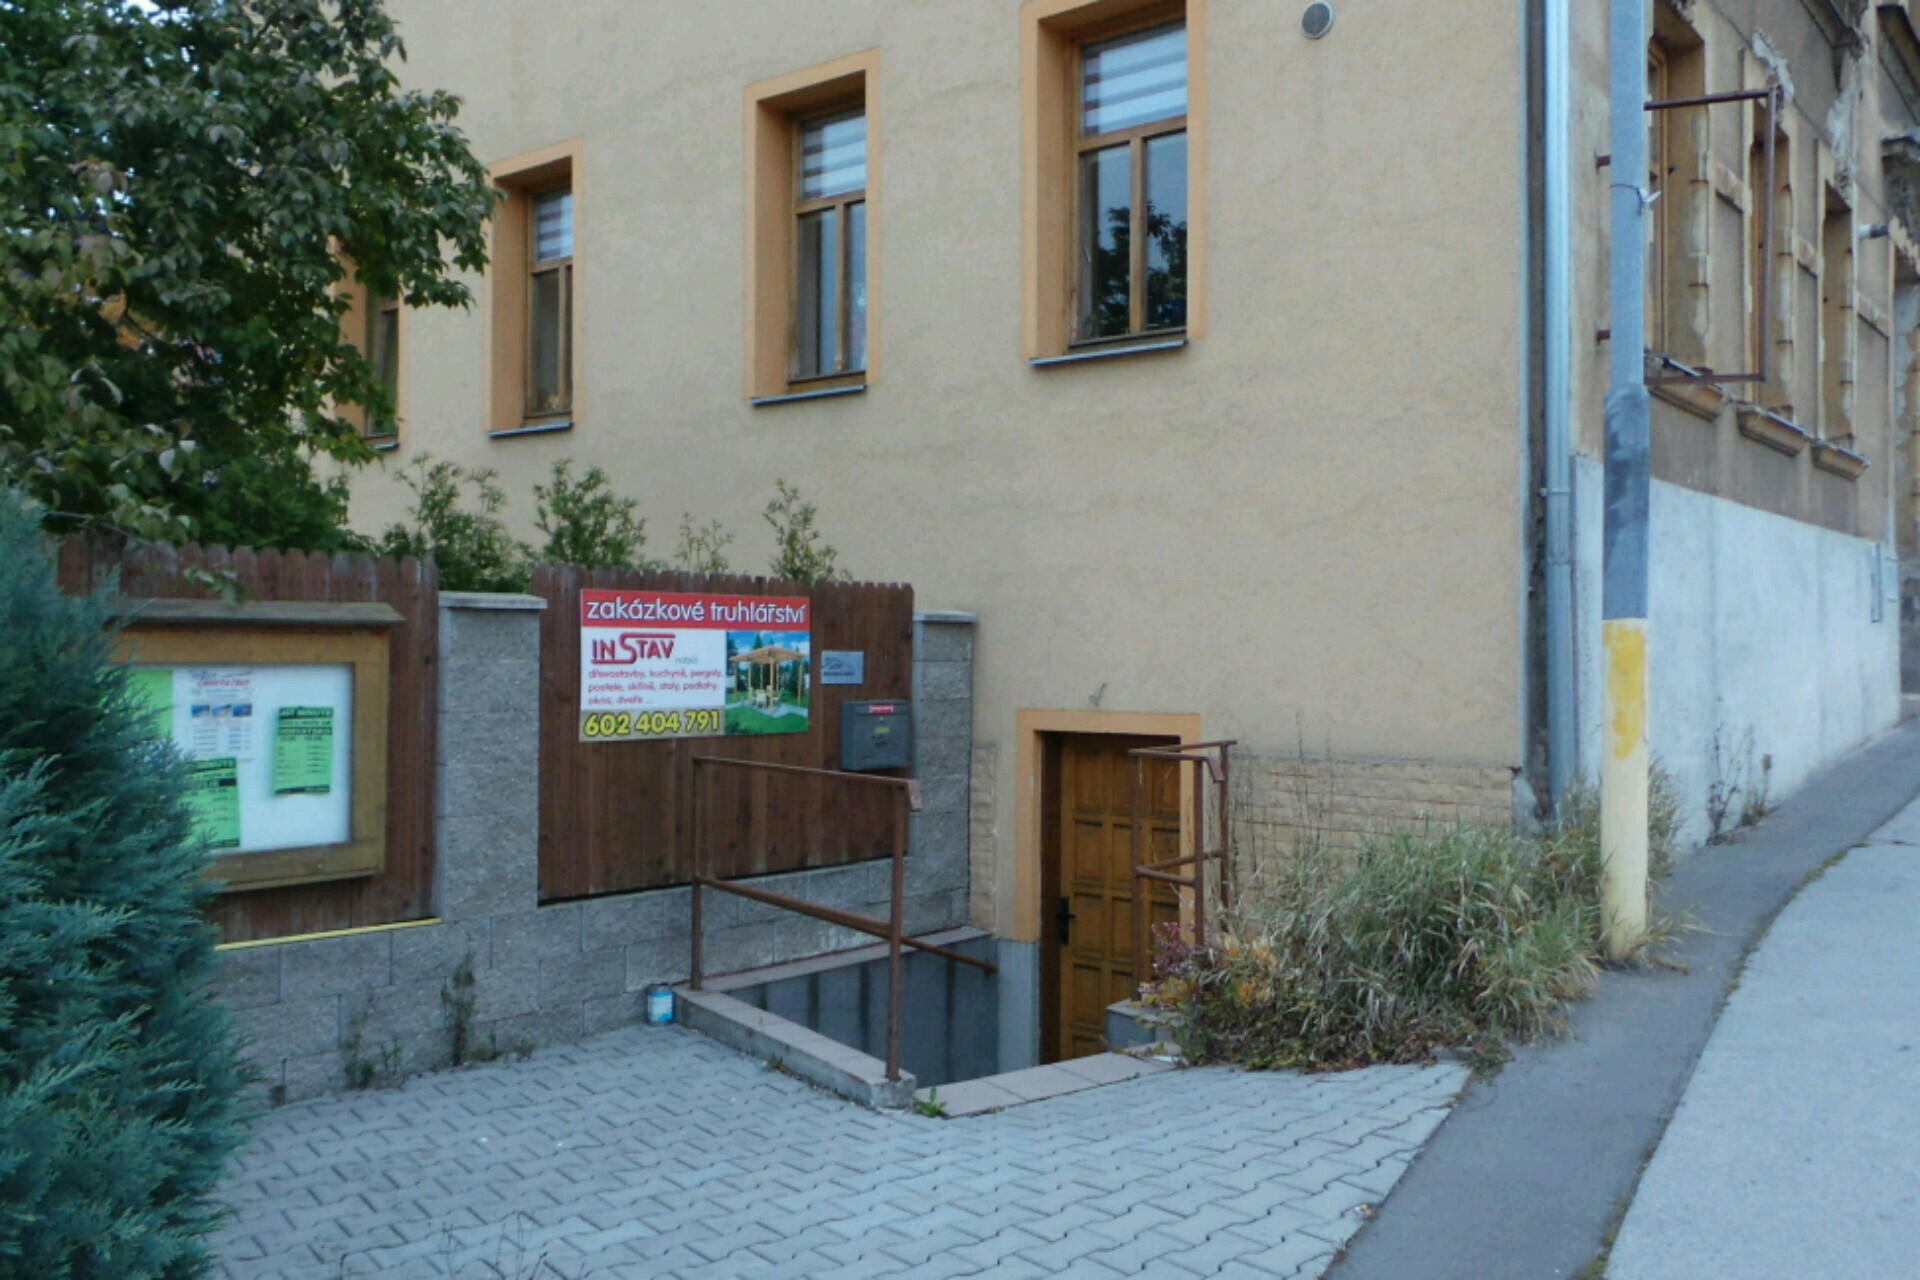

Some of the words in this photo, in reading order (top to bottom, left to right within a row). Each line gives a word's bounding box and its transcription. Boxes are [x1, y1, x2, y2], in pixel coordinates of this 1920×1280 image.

[587, 597, 704, 620] zakázkové
[710, 601, 806, 623] truhlářství
[584, 713, 630, 736] 602
[635, 711, 680, 734] 404
[685, 709, 720, 731] 791
